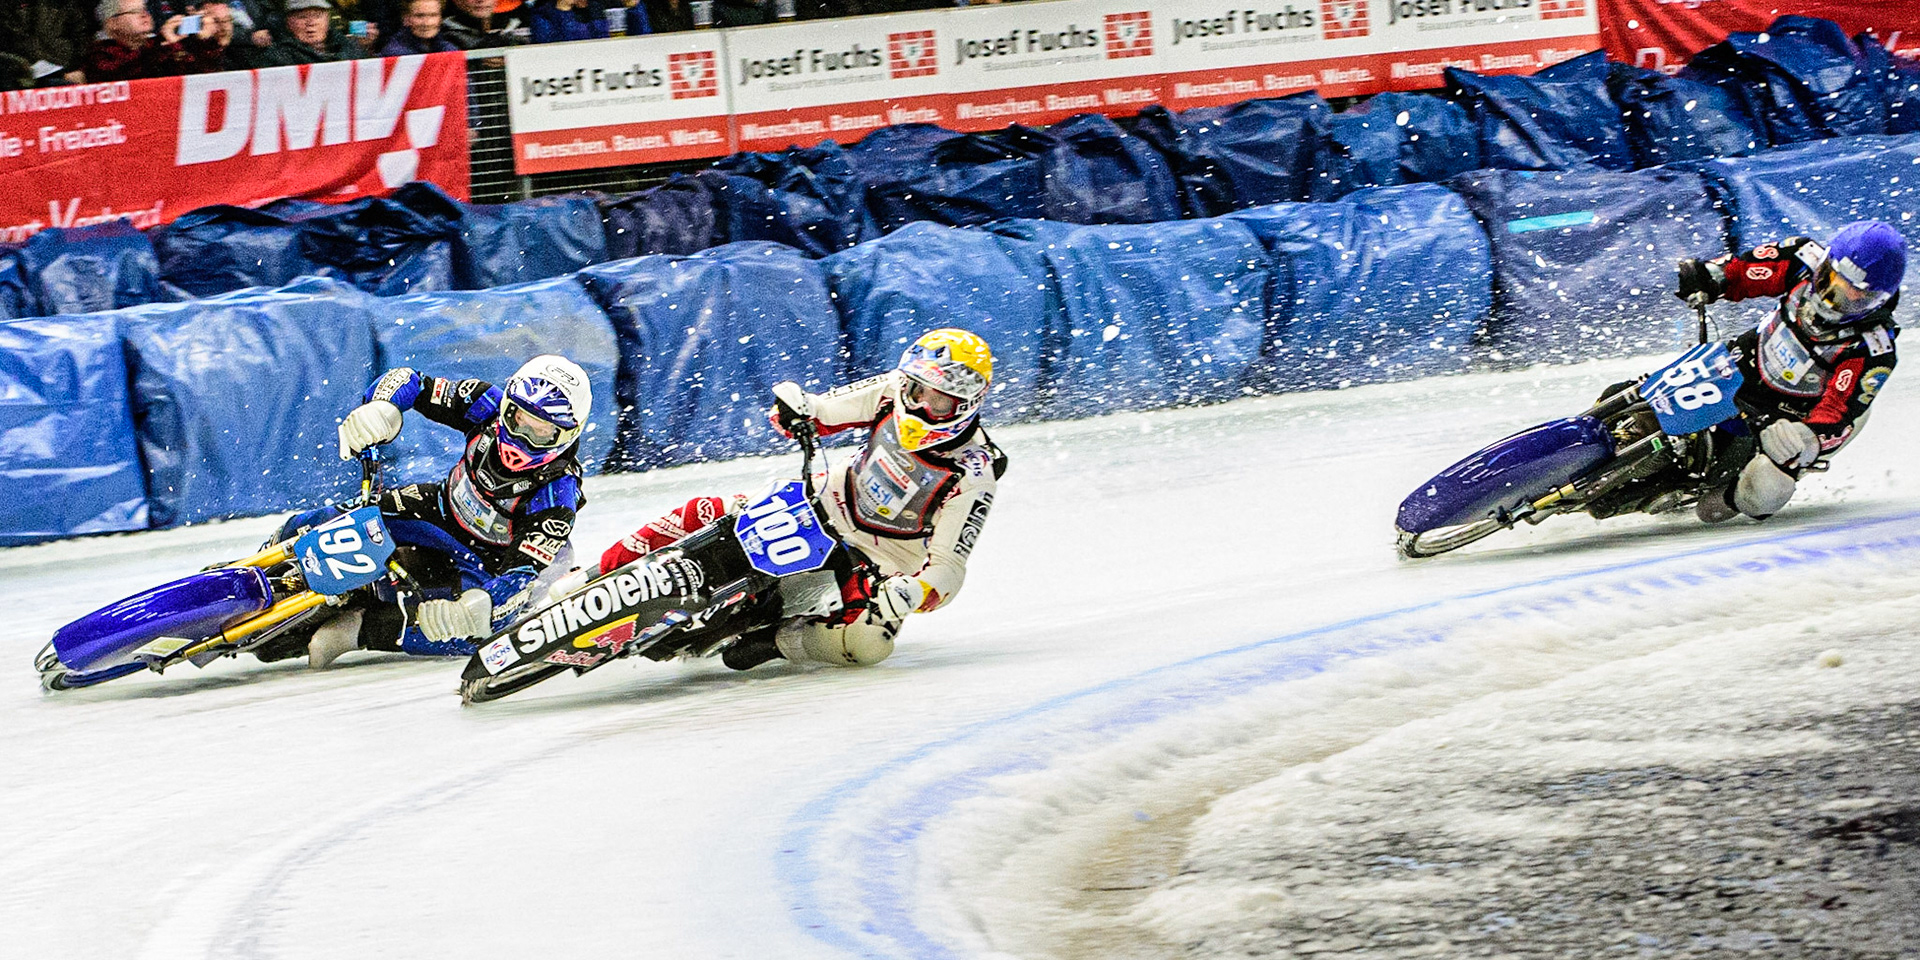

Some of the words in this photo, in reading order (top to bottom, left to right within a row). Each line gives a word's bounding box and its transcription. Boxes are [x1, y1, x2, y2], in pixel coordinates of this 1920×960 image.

[955, 29, 1021, 66] Josef
[1026, 24, 1099, 52] Fuchs
[1172, 10, 1236, 45] Josef
[1243, 5, 1315, 33] Fuchs
[520, 68, 585, 105] Josef
[591, 64, 663, 92] Fuchs
[739, 48, 805, 85] Josef
[811, 43, 883, 73] Fuchs
[1174, 78, 1263, 99] Menschen.
[1263, 74, 1321, 91] Bauen.
[1320, 68, 1375, 85] Werte.
[176, 54, 427, 166] DMV
[957, 98, 1044, 119] Menschen.
[1045, 94, 1103, 111] Bauen.
[1104, 87, 1159, 105] Werte.
[38, 119, 128, 153] Freizeit
[524, 138, 612, 160] Menschen.
[612, 134, 670, 152] Bauen.
[670, 128, 725, 147] Werte.
[741, 118, 829, 141] Menschen.
[829, 114, 887, 132] Bauen.
[886, 107, 943, 125] Werte.
[1663, 359, 1723, 411] 58
[317, 514, 377, 580] 192
[746, 495, 811, 566] 100
[517, 561, 674, 654] Silkolene
[485, 644, 512, 665] FUCHS
